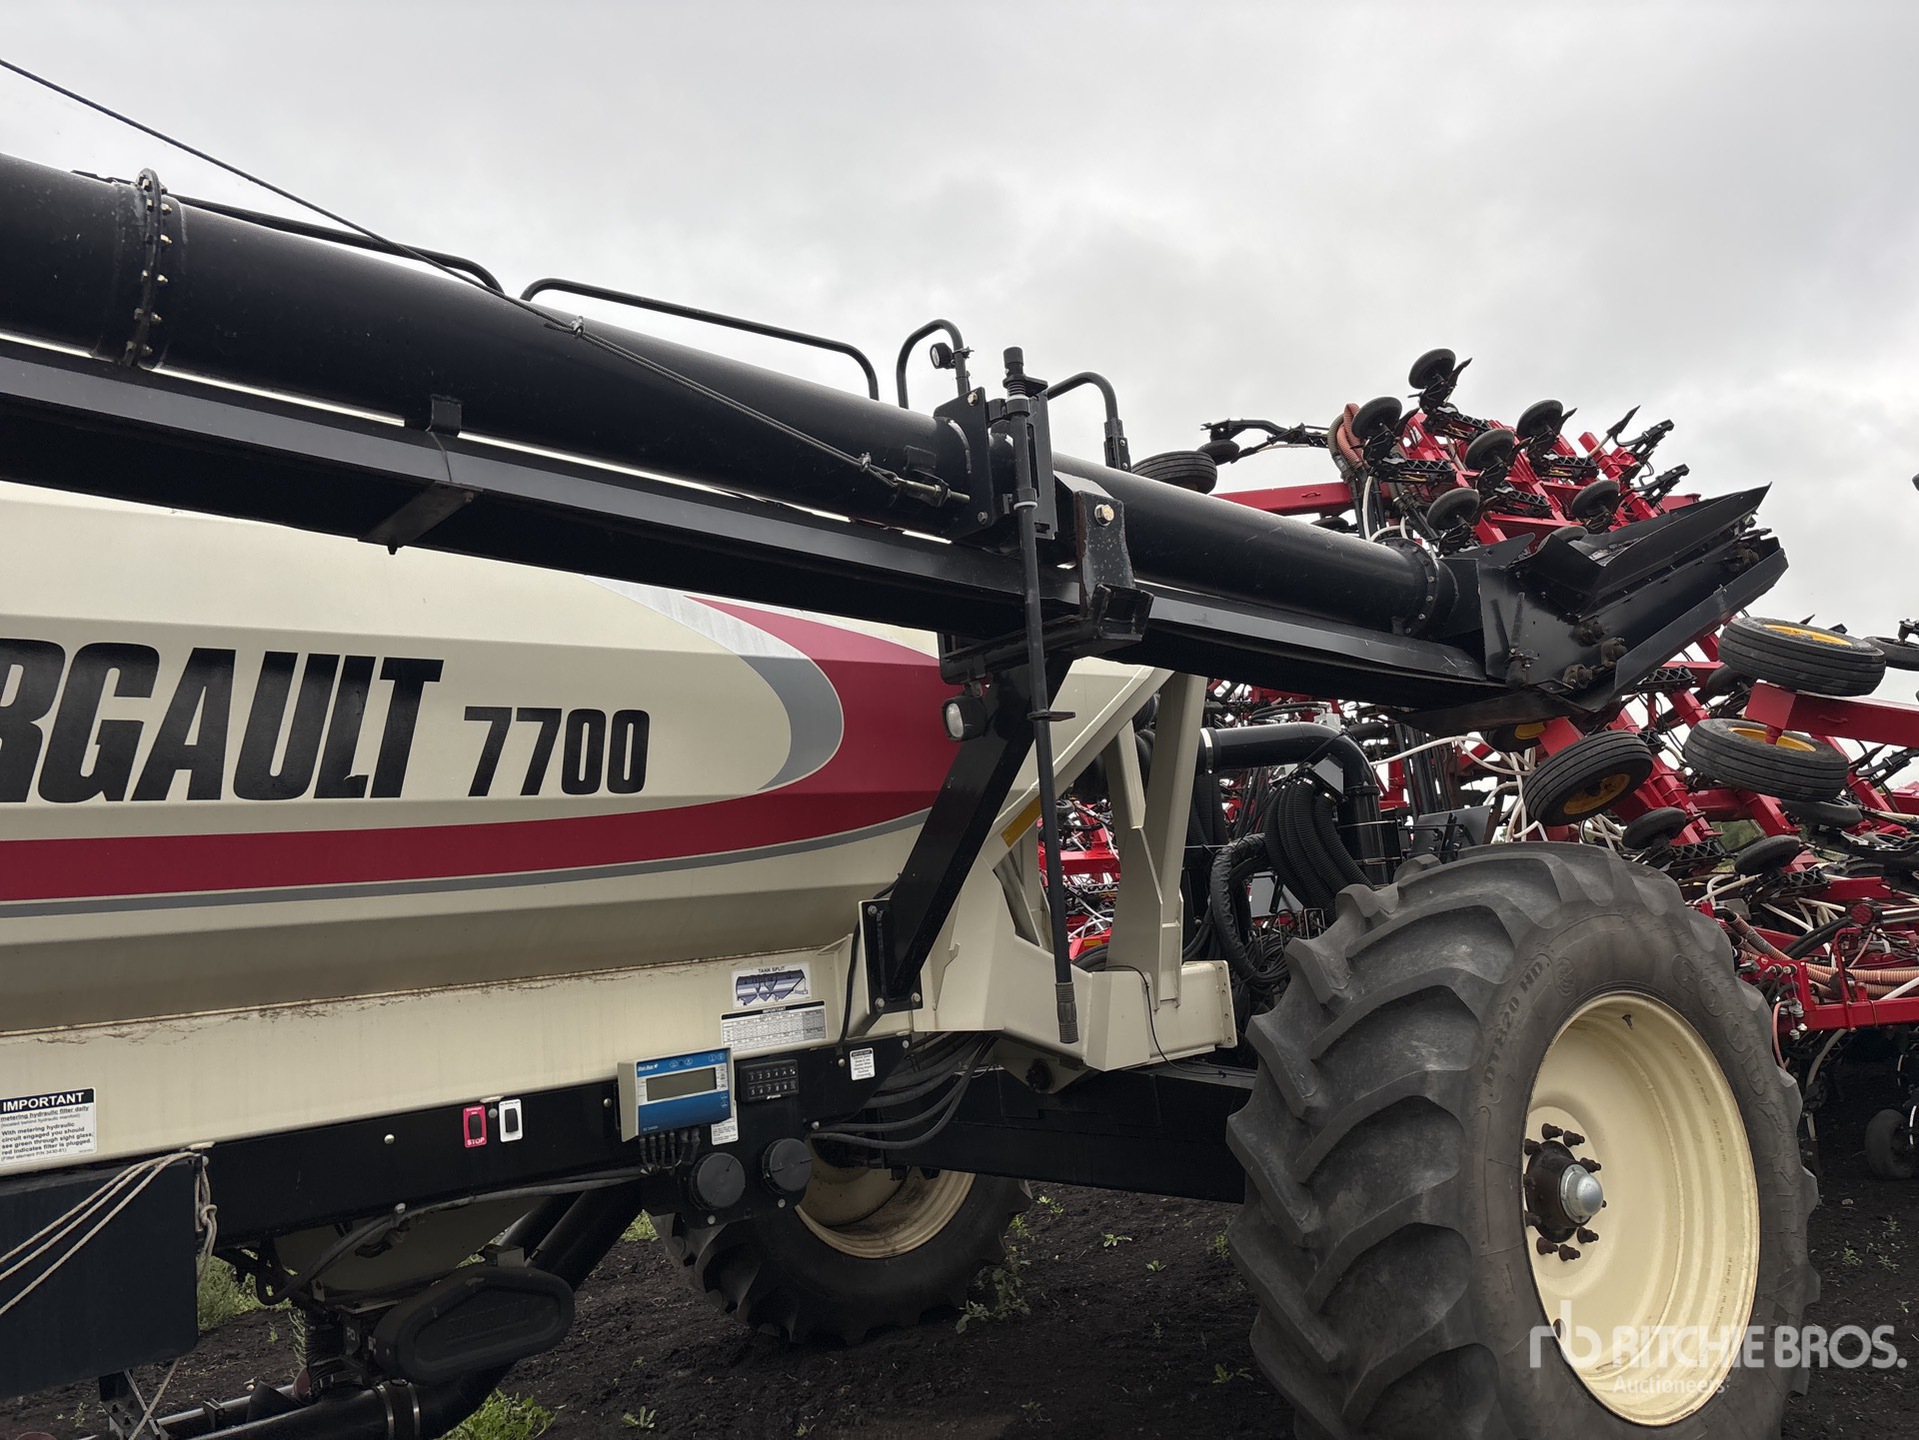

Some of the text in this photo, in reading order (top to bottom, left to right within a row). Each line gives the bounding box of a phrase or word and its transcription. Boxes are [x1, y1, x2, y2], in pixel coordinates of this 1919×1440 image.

[464, 706, 650, 797] 7700
[1519, 961, 1543, 993] HD
[3, 1092, 84, 1112] IMPORTANT
[29, 1109, 58, 1119] hydraulic
[75, 1105, 89, 1113] daily
[17, 1126, 45, 1135] metering
[46, 1122, 75, 1131] hydraulic
[23, 1132, 49, 1141] engaged
[64, 1127, 85, 1135] should
[34, 1137, 58, 1146] through
[59, 1134, 75, 1142] sight
[467, 1136, 485, 1146] STOP
[13, 1145, 42, 1154] indicates
